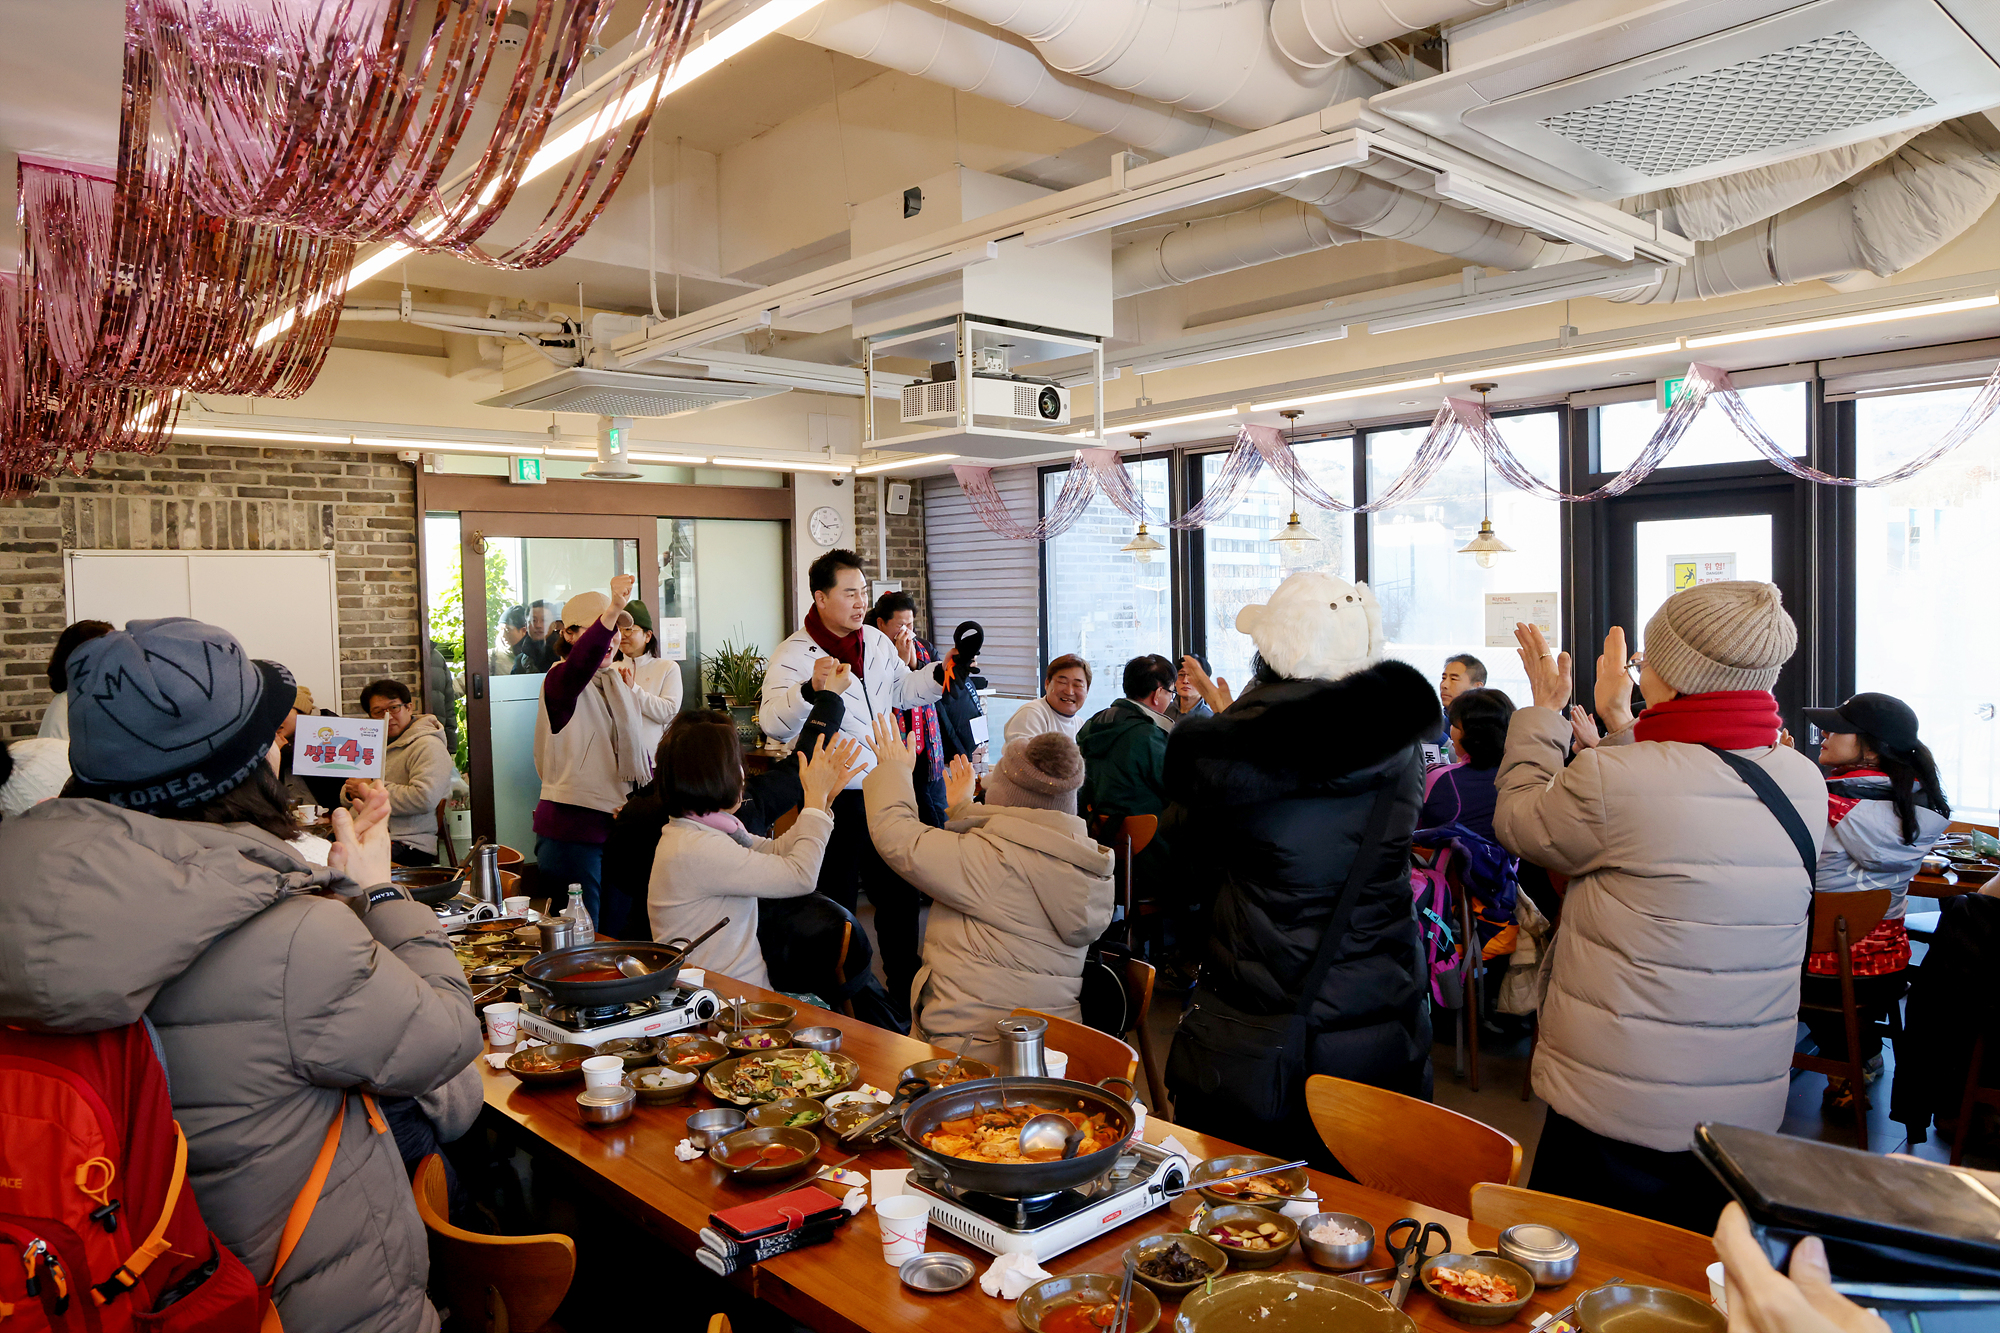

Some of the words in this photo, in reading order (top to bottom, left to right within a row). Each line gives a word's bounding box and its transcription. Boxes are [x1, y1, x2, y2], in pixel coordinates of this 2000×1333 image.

[304, 739, 374, 766] 쌍문4동
[109, 772, 209, 808] KOREA
[0, 1176, 23, 1189] ACE
